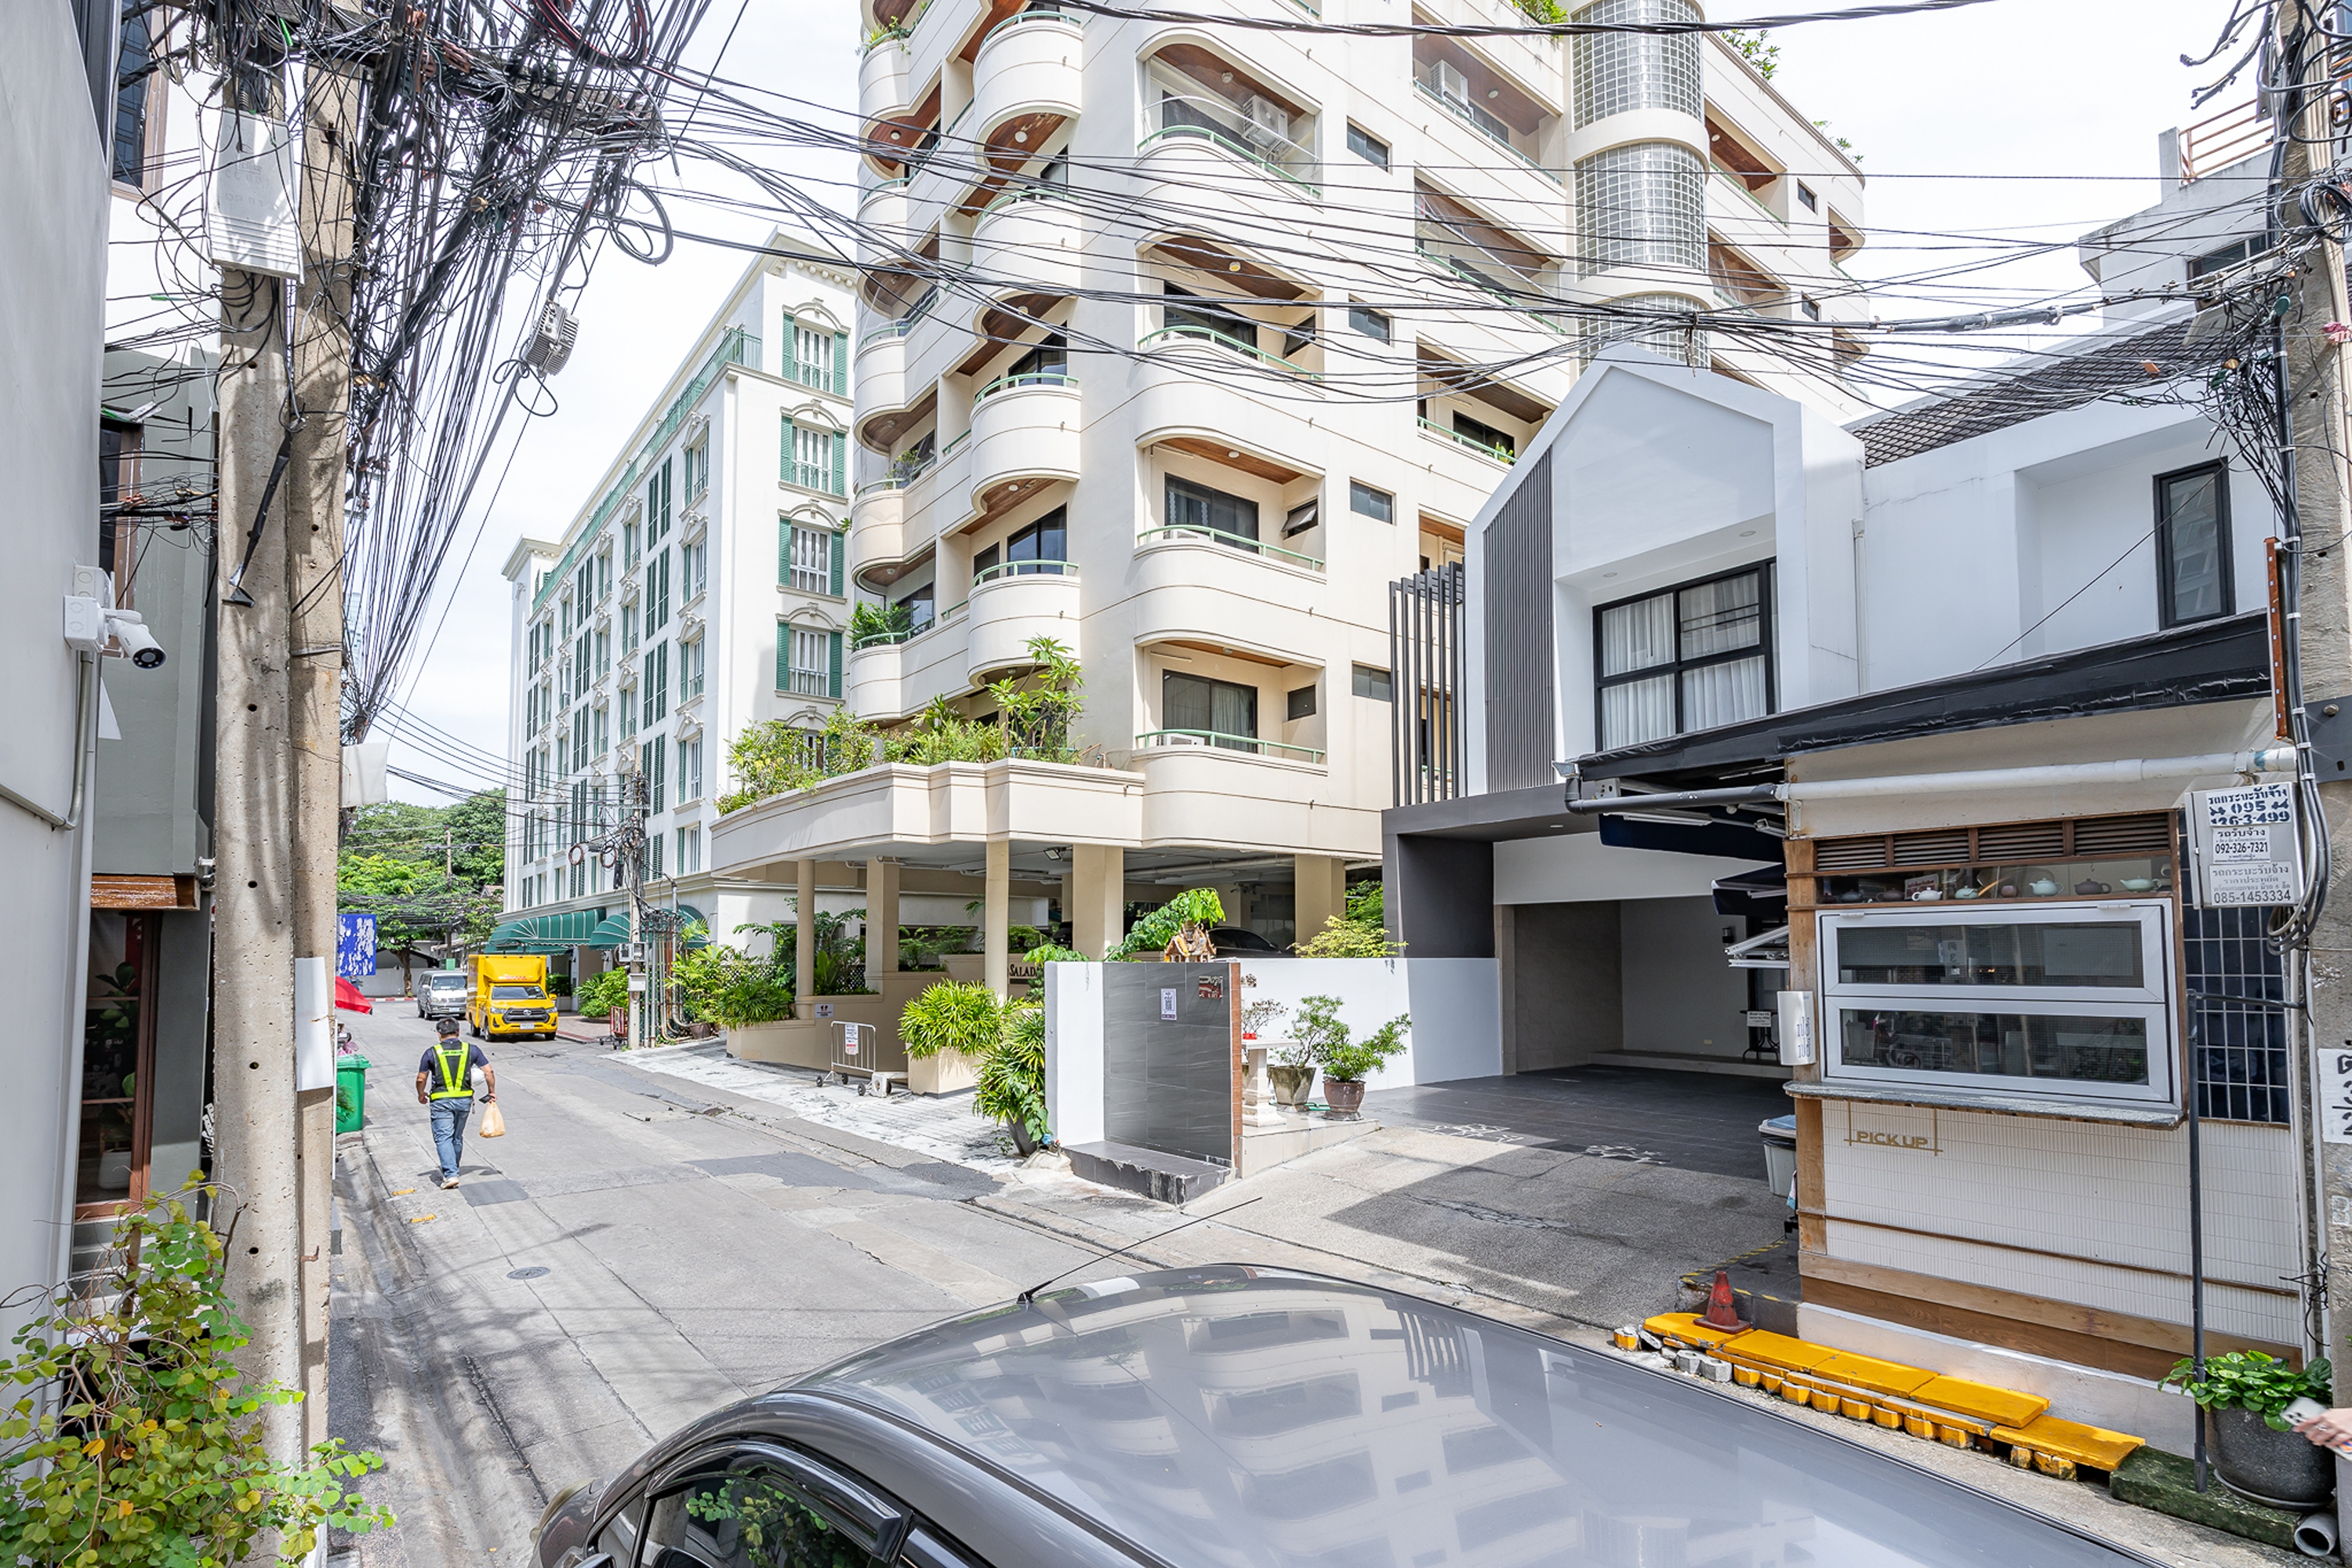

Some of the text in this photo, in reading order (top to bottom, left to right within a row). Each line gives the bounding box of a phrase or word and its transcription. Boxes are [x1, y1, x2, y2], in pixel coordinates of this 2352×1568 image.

[2209, 785, 2287, 804] รถกระบะรับจ้าง
[2231, 800, 2266, 814] 095
[2217, 827, 2265, 837] รถรับจ้าง
[2215, 842, 2268, 854] 092-326-7321
[2212, 863, 2288, 877] รถกระบะรับจ้าง
[2214, 890, 2291, 903] 085-1453334
[1857, 1131, 1928, 1149] PICK UP
